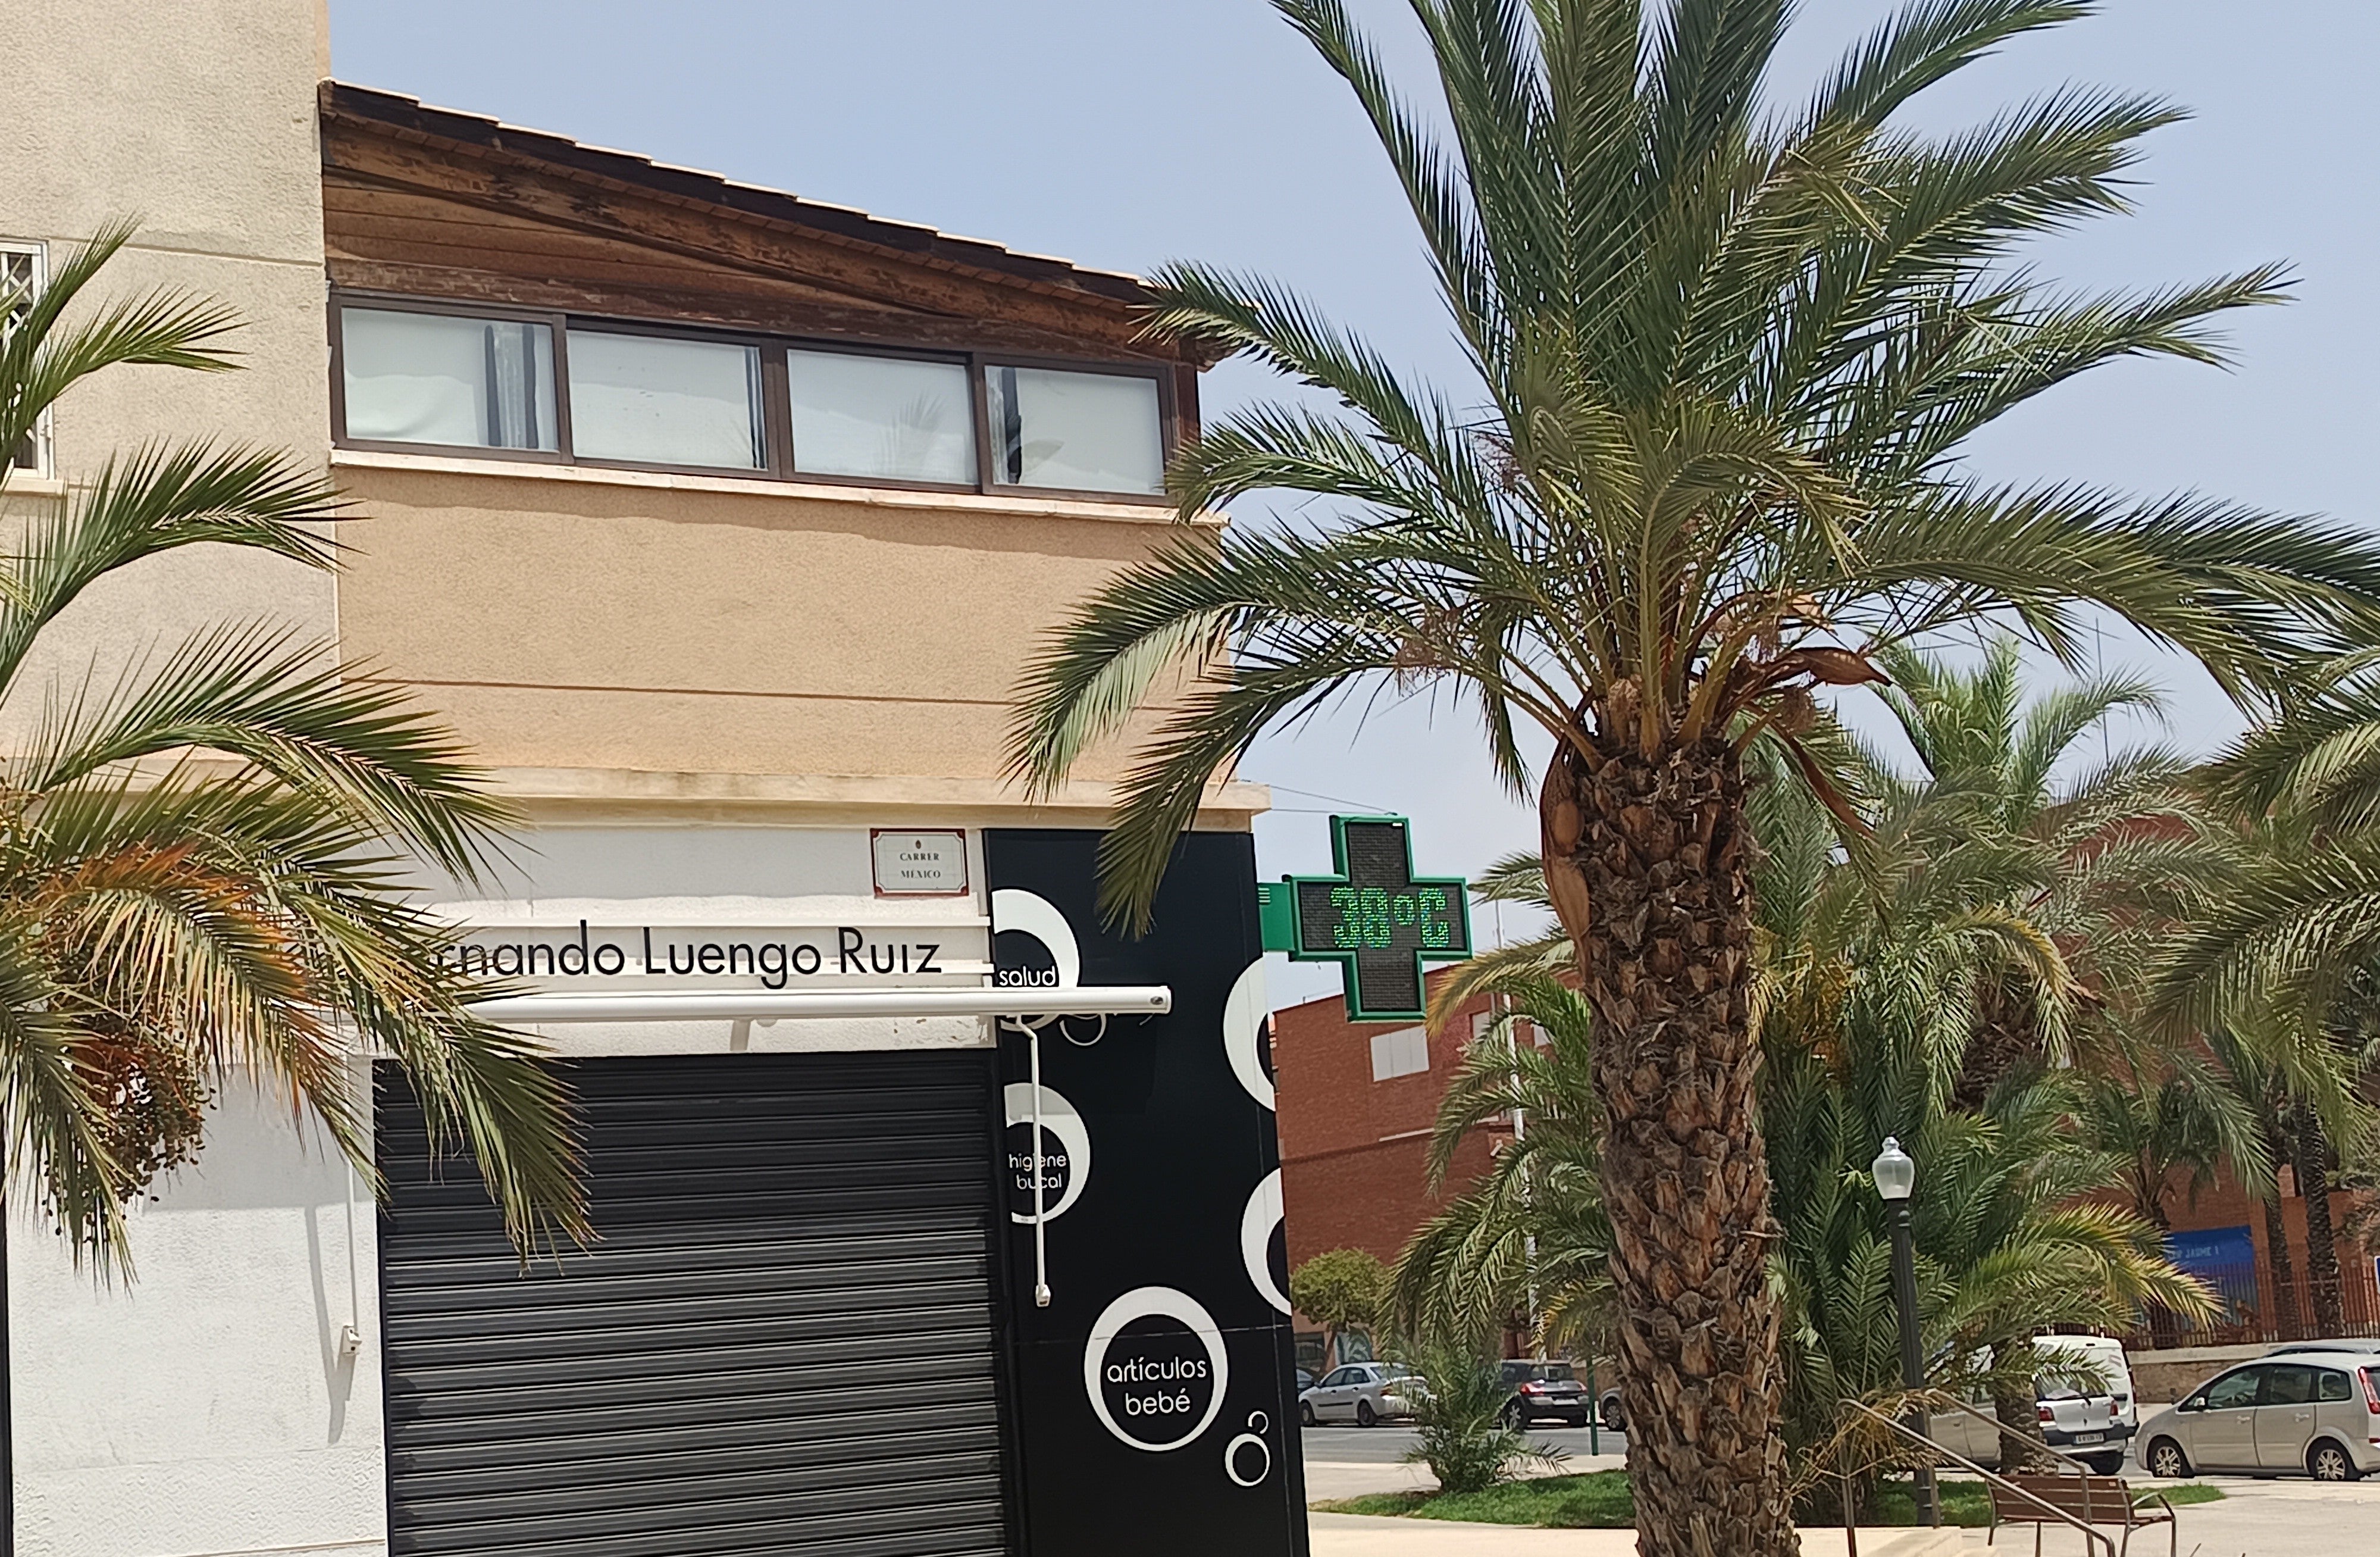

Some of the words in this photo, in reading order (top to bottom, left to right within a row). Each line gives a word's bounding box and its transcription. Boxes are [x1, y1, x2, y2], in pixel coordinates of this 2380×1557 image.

[900, 852, 940, 861] CARRER
[436, 919, 625, 976] rnando
[643, 926, 821, 990] Luengo
[838, 926, 942, 974] Ruiz
[999, 965, 1056, 986] salud
[1009, 1153, 1067, 1172] higene
[1016, 1173, 1062, 1190] bucal
[1107, 1356, 1207, 1382] artículos
[1125, 1387, 1191, 1416] bebé
